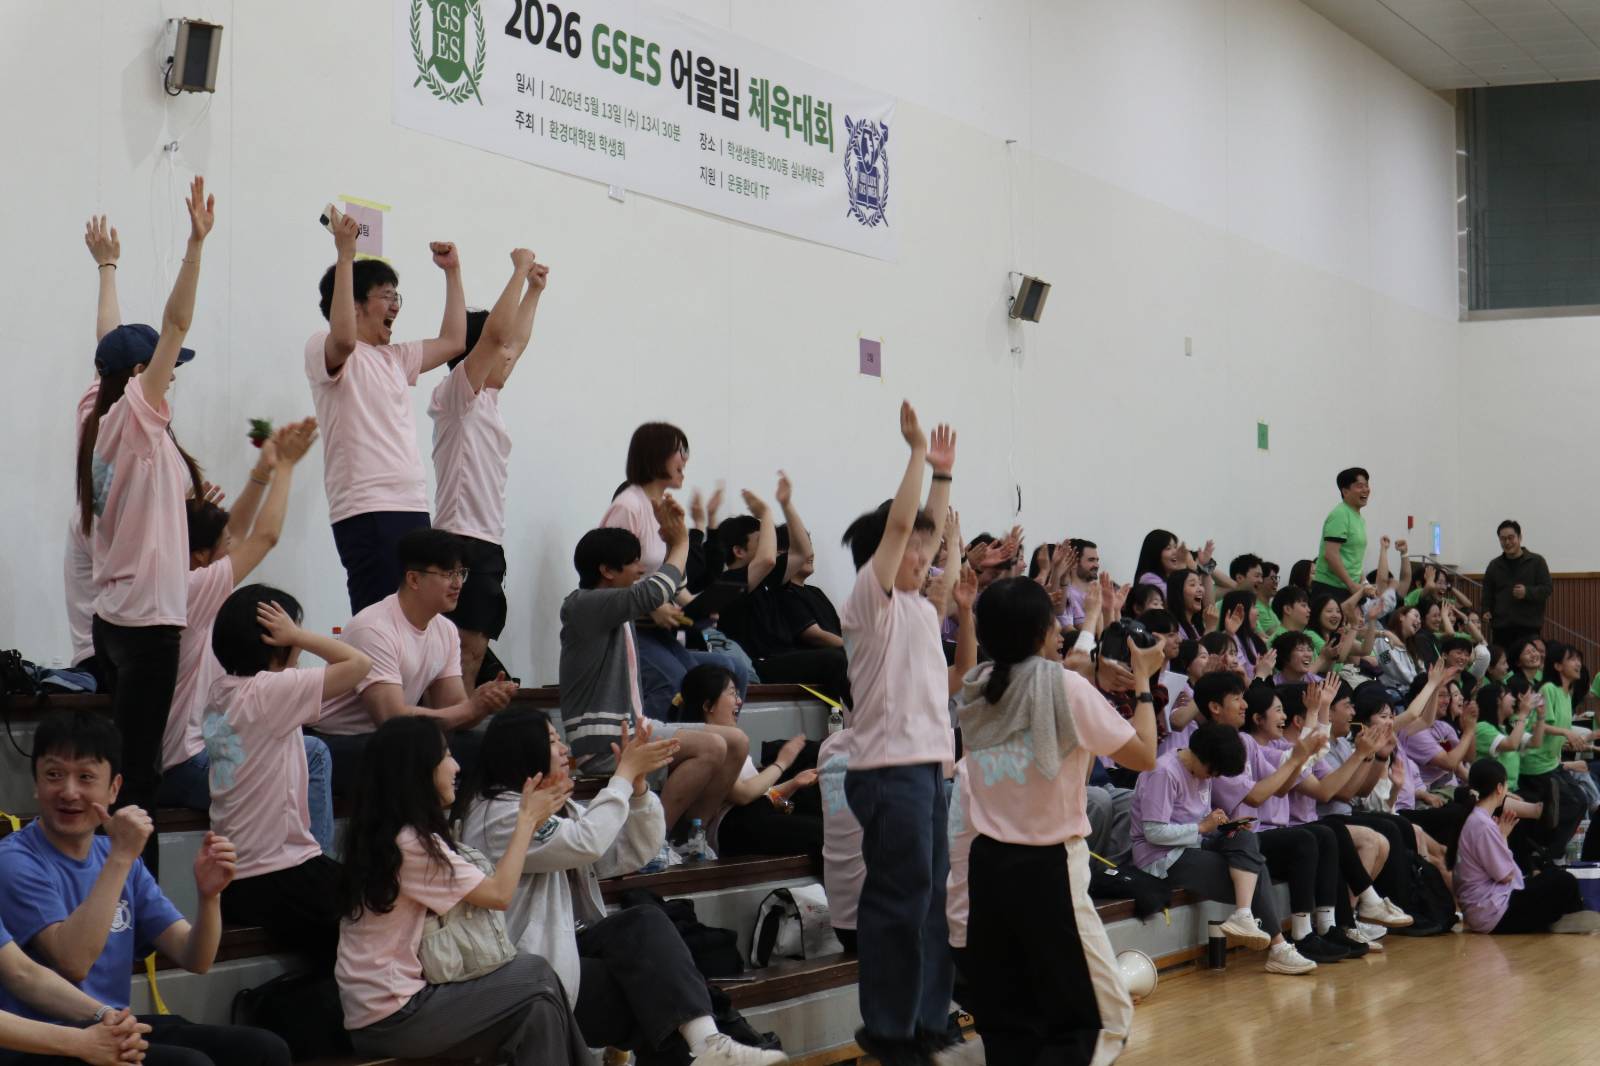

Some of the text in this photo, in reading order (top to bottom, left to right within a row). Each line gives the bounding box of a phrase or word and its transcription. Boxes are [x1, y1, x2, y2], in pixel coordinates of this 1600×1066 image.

[436, 1, 461, 33] GS
[436, 31, 461, 63] ES
[504, 0, 834, 153] 2026 GSES 어울림 체육대회
[515, 73, 681, 142] 일시 2026년 5월 13일 (수) 13시 30분
[514, 110, 626, 160] 주최 환경대학원 학생회
[699, 132, 716, 152] 장소
[699, 166, 716, 186] 지원
